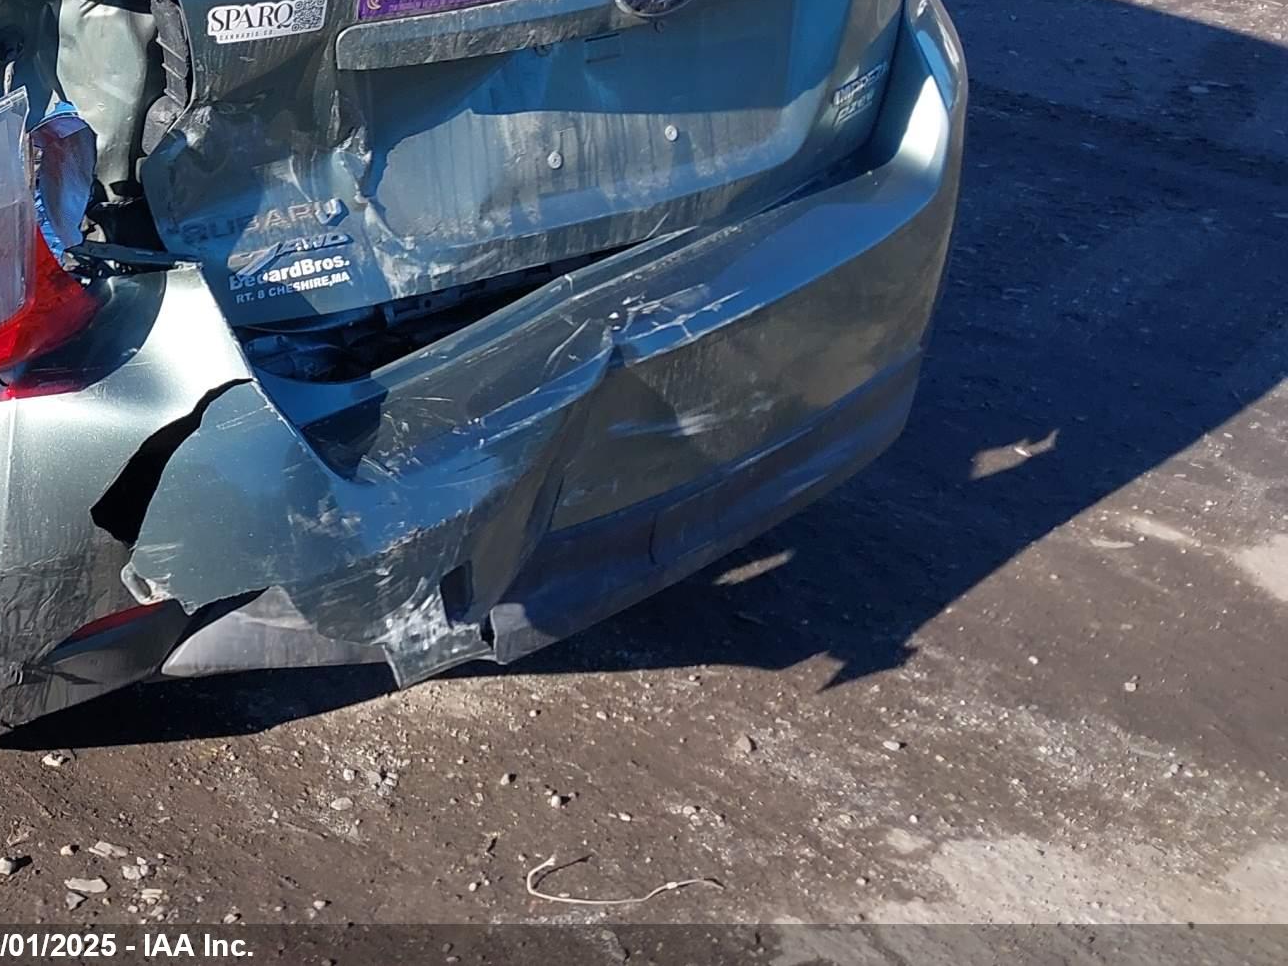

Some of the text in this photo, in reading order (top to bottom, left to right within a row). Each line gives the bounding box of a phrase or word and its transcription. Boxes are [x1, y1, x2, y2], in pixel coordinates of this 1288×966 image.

[211, 2, 293, 32] SPARQ
[235, 271, 351, 305] RT. 8 CHESHIRE,MA
